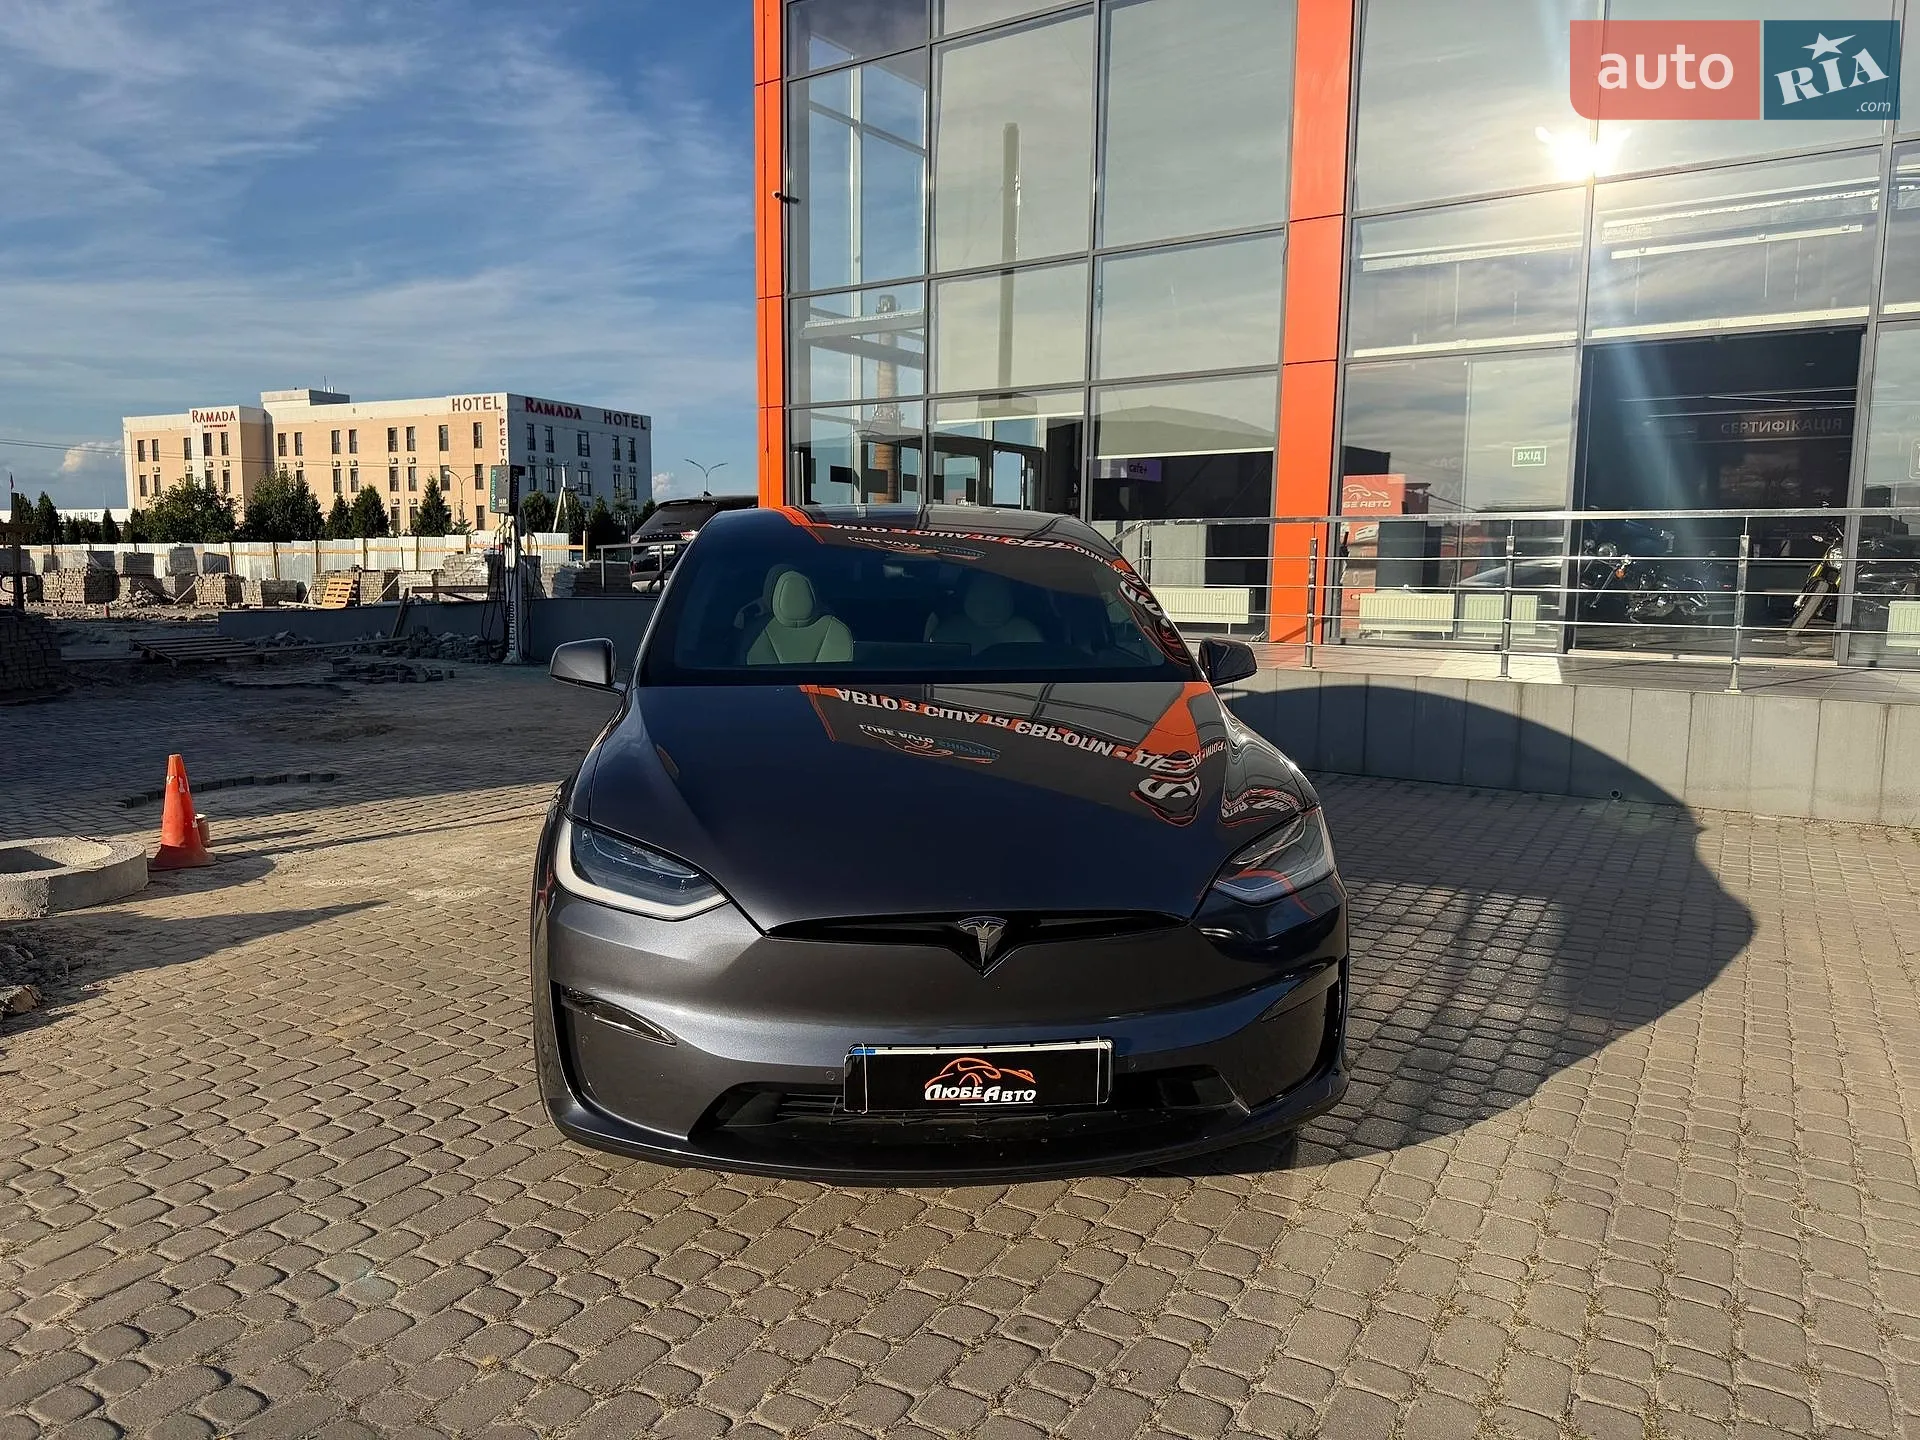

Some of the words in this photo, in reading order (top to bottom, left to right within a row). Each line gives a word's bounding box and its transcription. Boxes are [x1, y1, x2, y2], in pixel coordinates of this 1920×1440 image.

[452, 396, 502, 412] HOTEL
[192, 410, 236, 423] RAMADA
[525, 397, 582, 420] RAMADA
[603, 411, 647, 430] HOTEL
[1721, 417, 1843, 434] СЕРТИФІКАЦІЯ
[1517, 451, 1541, 461] ВХІД
